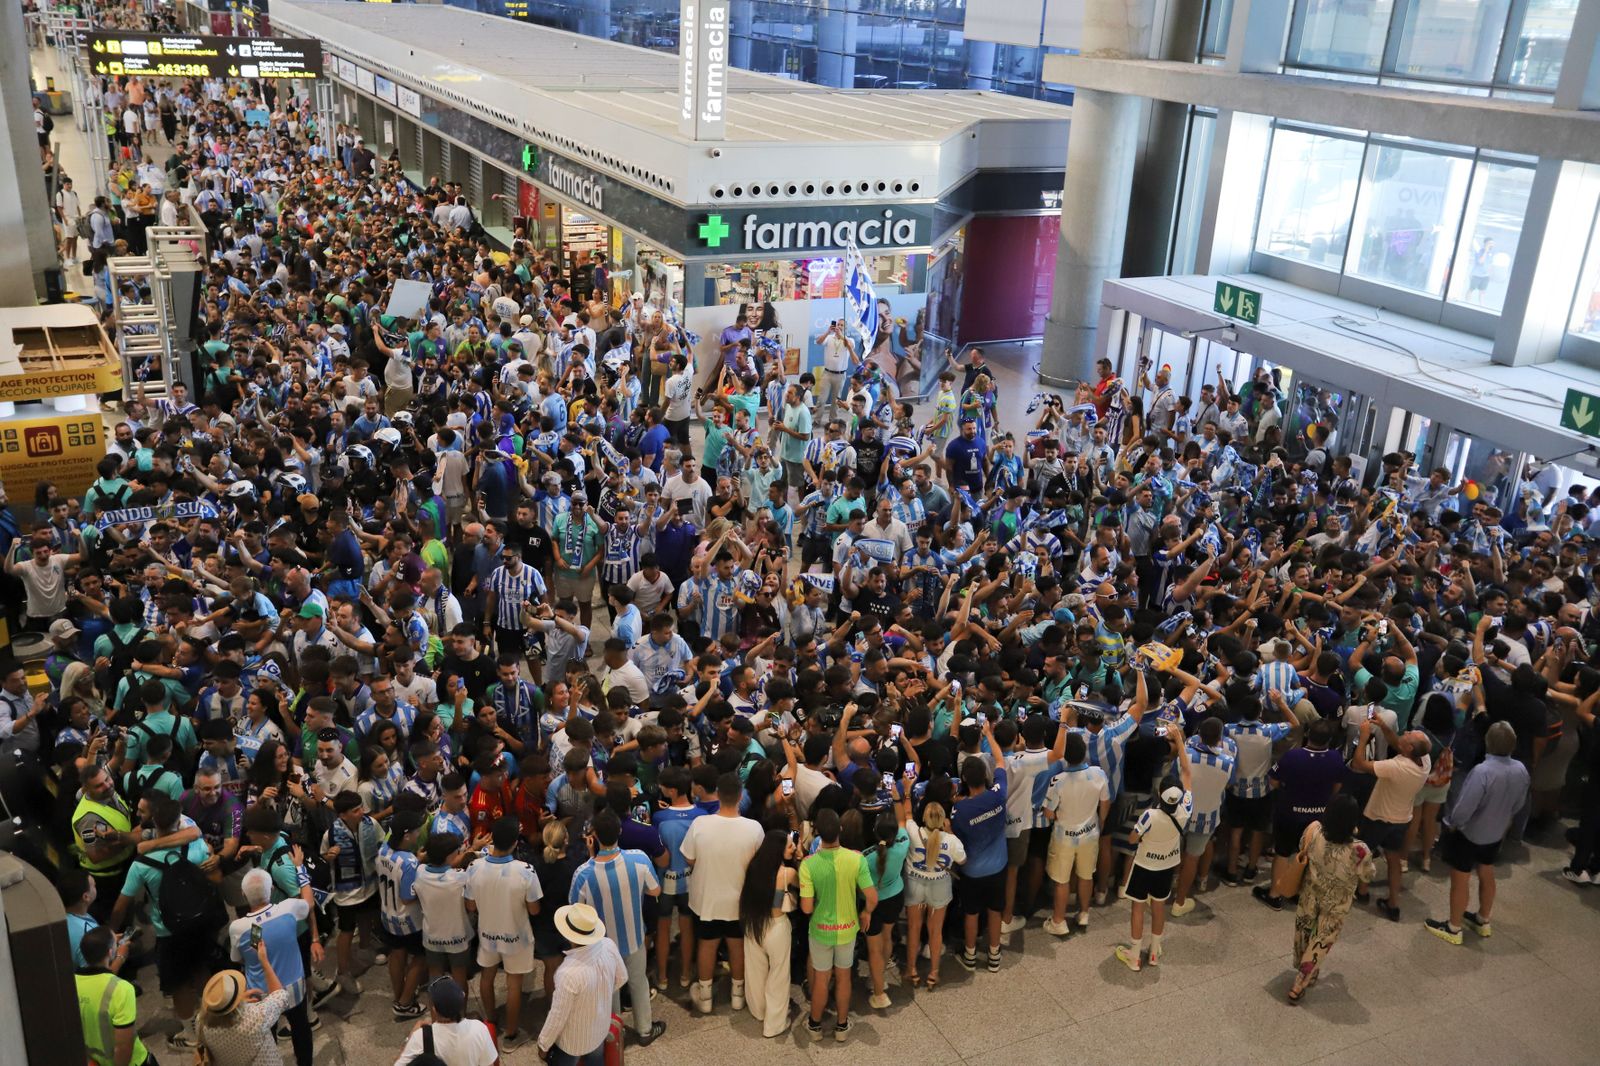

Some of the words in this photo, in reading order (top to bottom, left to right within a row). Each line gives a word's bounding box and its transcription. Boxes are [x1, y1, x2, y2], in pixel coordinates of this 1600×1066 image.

[185, 63, 210, 77] 386
[682, 5, 694, 120] farmacia
[702, 7, 725, 123] farmacia
[548, 156, 602, 210] farmacia
[744, 209, 916, 249] farmacia
[26, 372, 95, 387] PROTECTION
[47, 381, 96, 393] EQUIPAJES
[41, 457, 93, 467] PROTECTION
[105, 506, 153, 524] ONDO
[1293, 806, 1326, 814] BENAHAV
